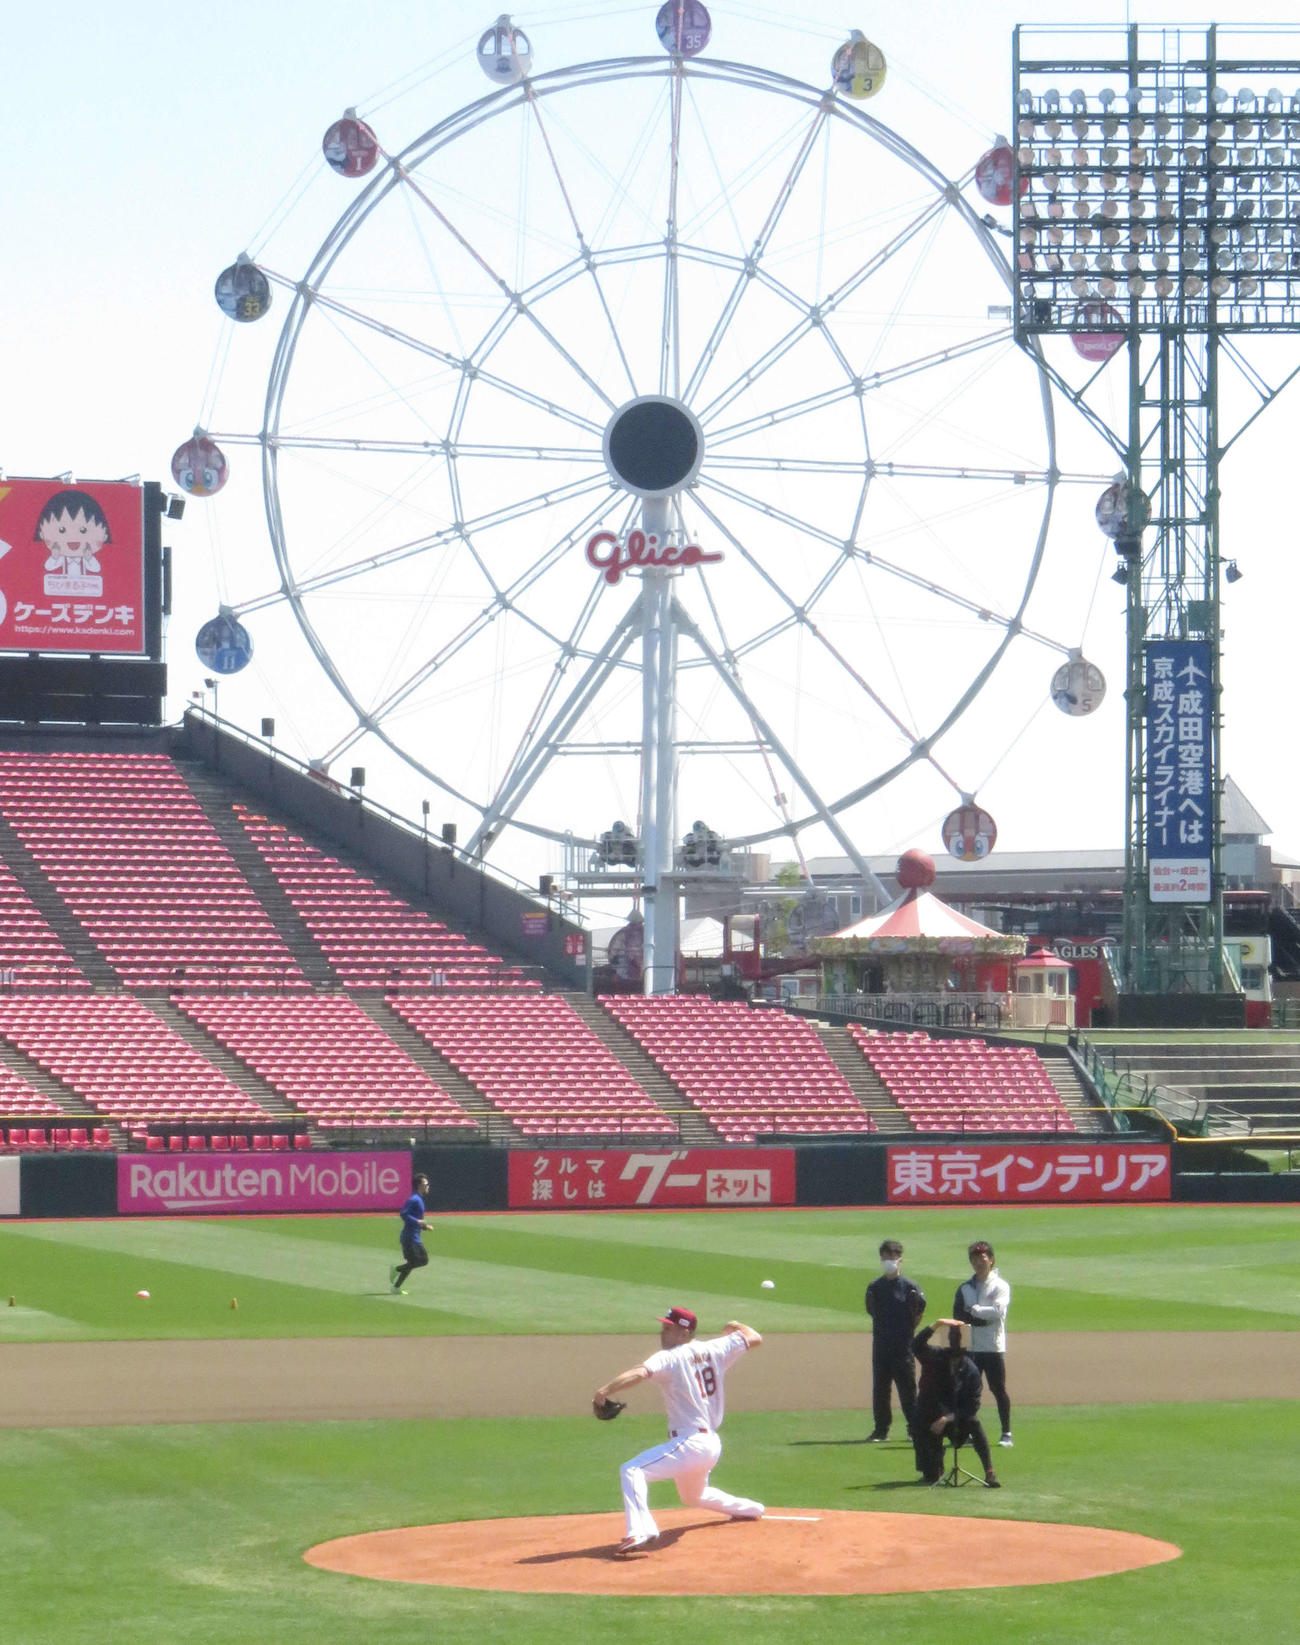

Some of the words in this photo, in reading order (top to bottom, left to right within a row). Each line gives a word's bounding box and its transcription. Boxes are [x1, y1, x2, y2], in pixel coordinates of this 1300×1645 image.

[686, 35, 702, 49] 35
[863, 78, 873, 92] 3
[14, 602, 135, 625] ケーズデンキ
[1152, 656, 1175, 846] 京成スカイライナー
[1178, 690, 1204, 844] 成田空港へは
[533, 1156, 604, 1175] クルマ
[892, 1150, 1167, 1196] 東京インテリア
[130, 1162, 282, 1198] Rakuten
[290, 1161, 400, 1196] Mobile
[532, 1179, 605, 1200] 探しは
[710, 1175, 767, 1199] ネット
[695, 1366, 716, 1399] 18
